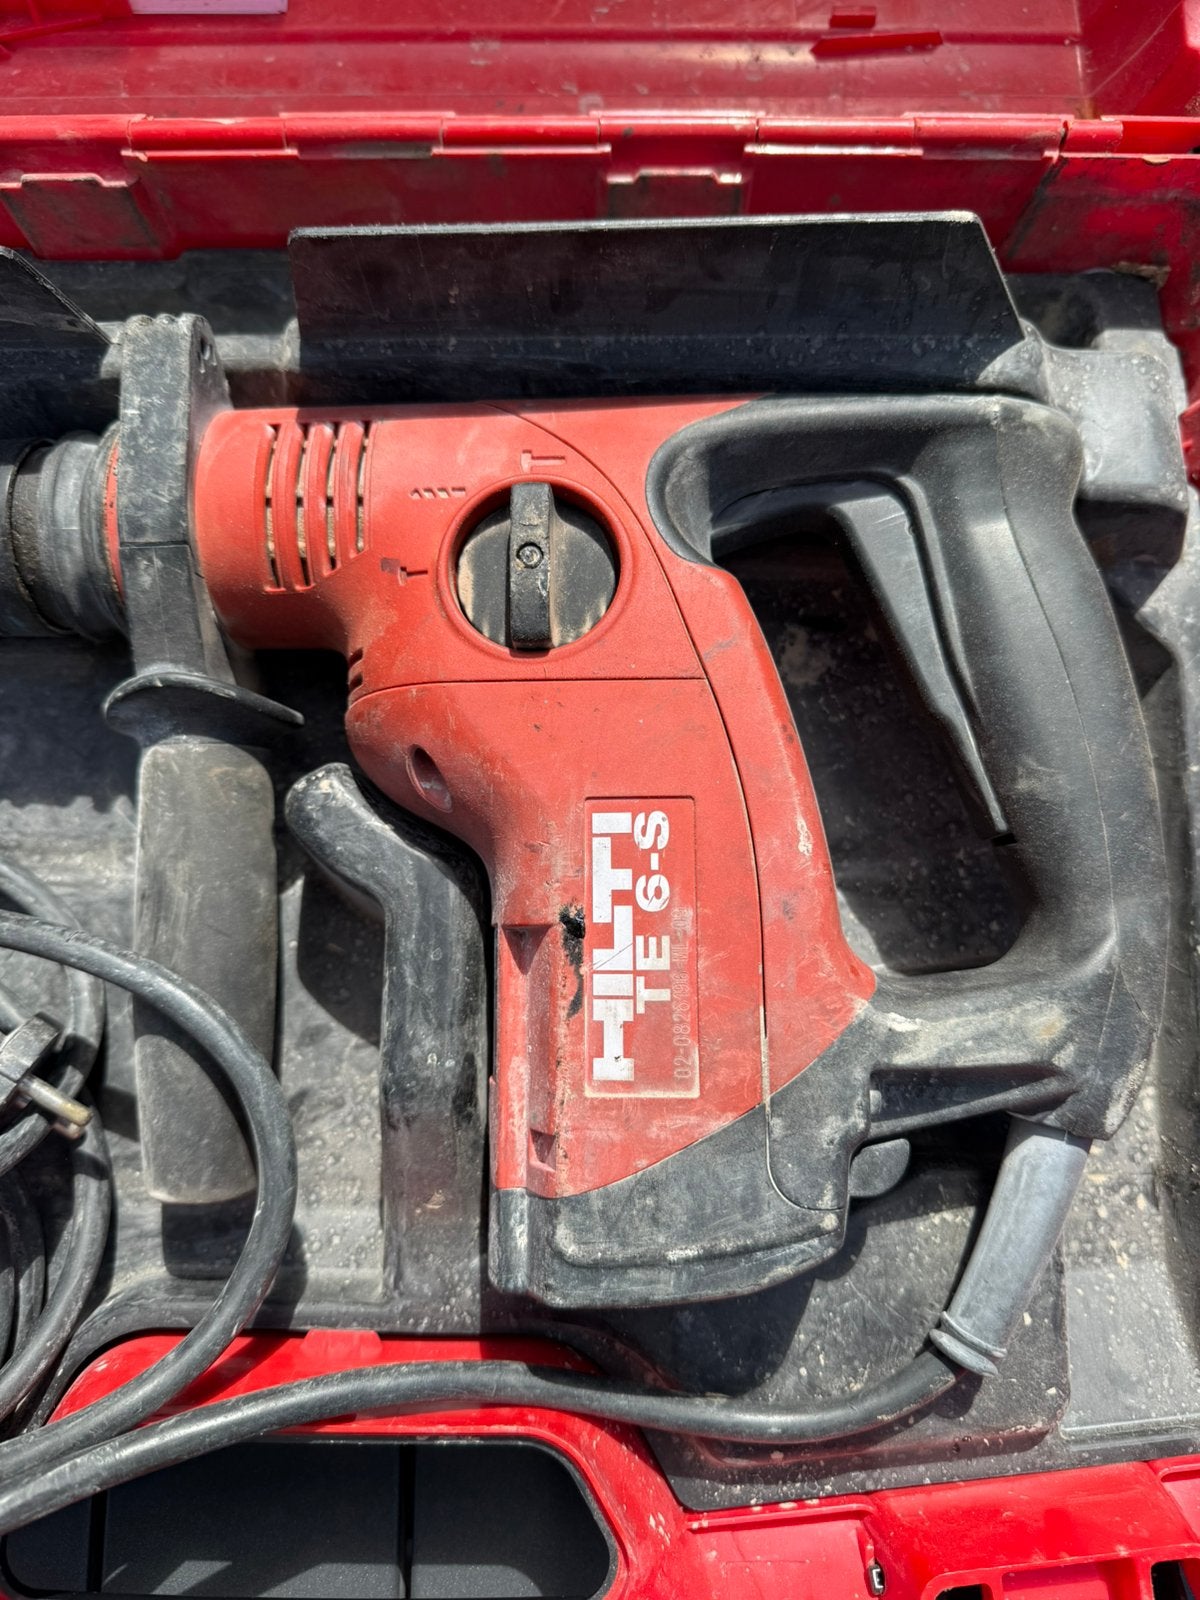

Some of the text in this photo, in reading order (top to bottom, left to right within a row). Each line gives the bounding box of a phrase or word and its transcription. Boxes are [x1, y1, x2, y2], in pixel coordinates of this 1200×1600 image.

[592, 812, 634, 1081] HILTI
[634, 810, 671, 1014] TE 6-S
